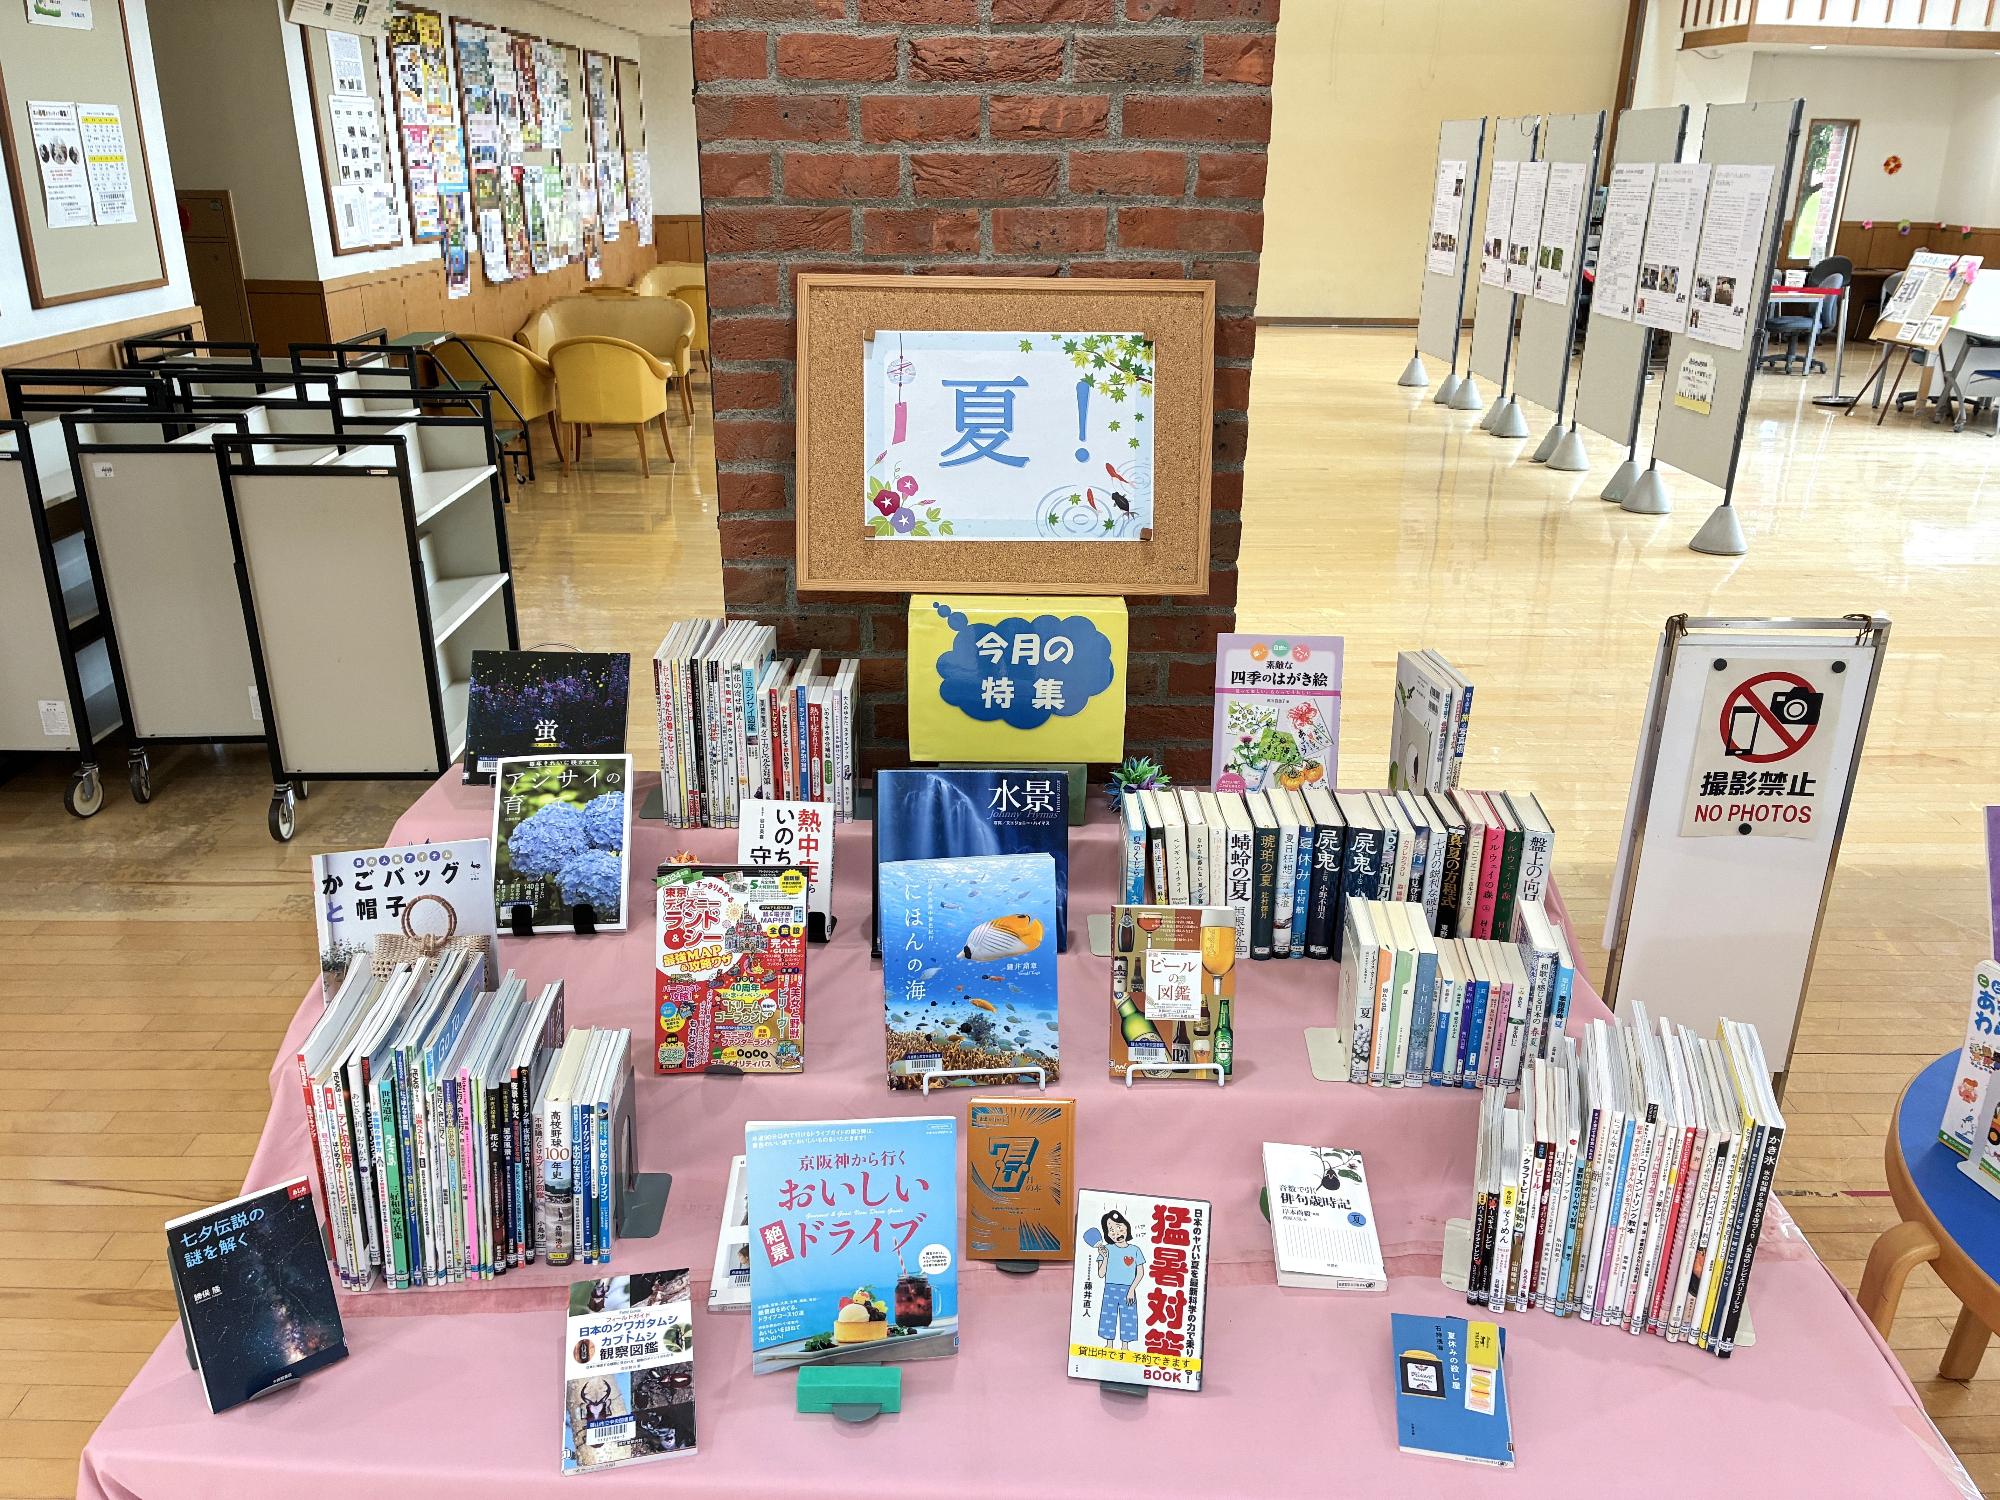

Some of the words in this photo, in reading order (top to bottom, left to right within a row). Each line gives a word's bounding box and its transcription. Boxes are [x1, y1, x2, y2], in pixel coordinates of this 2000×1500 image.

[975, 631, 1074, 666] 今月の
[1230, 670, 1328, 687] 四季のはがき絵
[1266, 660, 1293, 670] 素敵な
[981, 676, 1066, 710] 特集
[533, 719, 558, 742] 蛍
[505, 768, 621, 792] アジサイの
[1699, 771, 1816, 797] 撮影禁止
[503, 791, 619, 815] 育て方
[987, 779, 1055, 812] 水景
[986, 809, 1020, 820] Johnny
[1026, 810, 1059, 821] Hymas
[1694, 804, 1722, 822] NO
[1727, 804, 1812, 824] PHOTOS
[774, 809, 795, 865] いのち
[1314, 830, 1341, 872] 屍鬼
[1133, 835, 1141, 876] 夏のくじら
[1174, 838, 1182, 893] ペンギン・ハイウェイ
[1229, 834, 1251, 901] 蜻蛉の夏
[1260, 835, 1275, 888] 琥珀の夏
[1282, 834, 1294, 875] 夏日狂想
[1296, 837, 1313, 882] 夏休み
[1349, 832, 1377, 876] 屍鬼
[1483, 834, 1497, 899] ノルウェイの森
[321, 861, 460, 895] かごバッグ
[1441, 833, 1462, 909] 真夏の方程式
[665, 888, 688, 898] 東京
[665, 898, 720, 910] ディズニー
[1317, 885, 1328, 920] 小野不由美
[326, 896, 407, 923] と帽子
[664, 910, 720, 929] ランド
[684, 930, 722, 947] シー
[770, 939, 800, 948] 完ベキ
[905, 884, 926, 1000] にほんの海
[663, 946, 722, 967] 最強MAP
[1151, 958, 1197, 973] ビール
[730, 983, 760, 992] 40周年
[1158, 985, 1191, 1001] 図鑑
[1168, 973, 1179, 984] の
[790, 988, 800, 1039] 美女と野獣
[1360, 1007, 1371, 1018] 夏
[686, 1020, 697, 1068] もれなく解説
[333, 1071, 342, 1092] PEAKS
[412, 1068, 420, 1092] PEAKS
[381, 1090, 393, 1122] 世界遺産
[338, 1113, 352, 1168] テント泊の山登り
[582, 1113, 590, 1153] スノーケリング
[799, 1150, 906, 1171] 京阪神から行く
[1764, 1136, 1780, 1165] かき氷
[778, 1171, 930, 1211] おいしい
[1515, 1158, 1530, 1228] クラフトビール事始め
[1532, 1168, 1543, 1190] ビール
[1280, 1192, 1352, 1210] 俳句歳時記
[1626, 1158, 1647, 1234] フローズンドリンク教本
[180, 1207, 265, 1248] 七夕伝説の
[1351, 1214, 1364, 1226] 夏
[1500, 1209, 1512, 1243] そうめん
[183, 1232, 249, 1268] 謎を解く
[763, 1225, 789, 1263] 絶景
[798, 1212, 928, 1259] ドライブ
[1082, 1281, 1092, 1318] 藤井直人
[1143, 1204, 1193, 1370] 猛暑対策
[579, 1315, 679, 1338] 日本のクワガタムシ
[606, 1312, 651, 1323] フィールドガイド
[600, 1340, 659, 1361] 観察図鑑
[601, 1332, 657, 1347] カブトムシ
[1078, 1345, 1127, 1361] 貸出中です
[1132, 1353, 1191, 1368] 予約できます
[1447, 1331, 1460, 1390] 夏休みの殺し屋
[1143, 1369, 1182, 1383] BOOK
